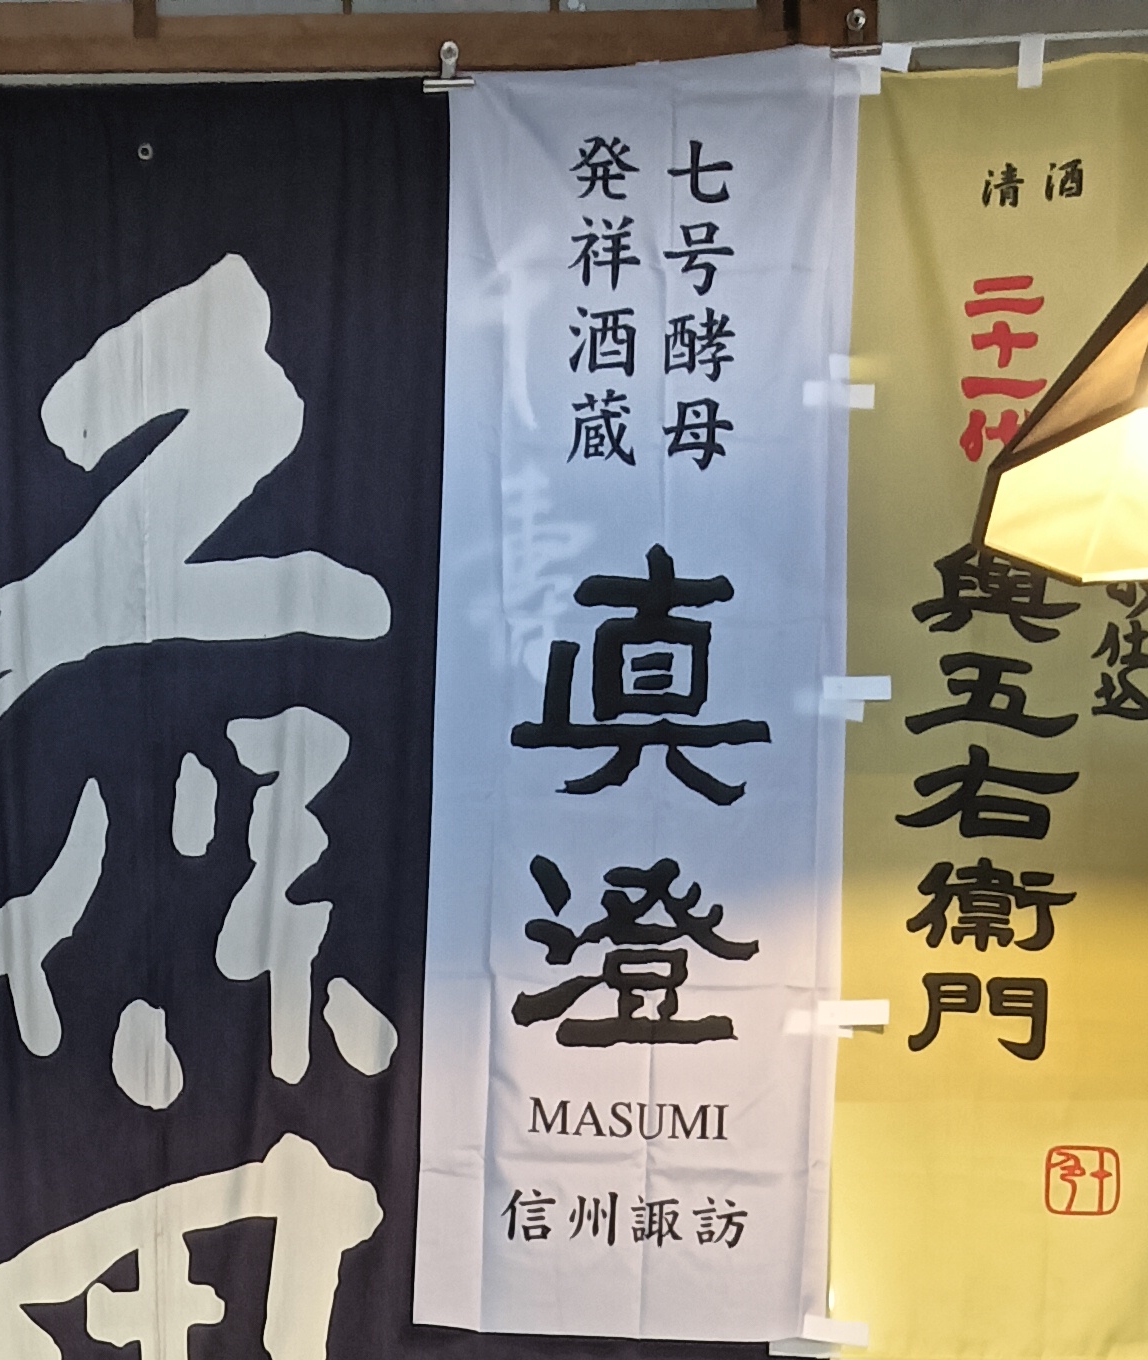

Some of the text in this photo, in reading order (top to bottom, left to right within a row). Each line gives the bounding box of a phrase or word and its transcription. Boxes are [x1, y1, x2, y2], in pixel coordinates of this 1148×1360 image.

[981, 158, 1086, 208] 清酒
[567, 135, 641, 466] 発祥酒蔵
[663, 140, 735, 470] 七号酵母
[510, 543, 773, 1046] 真澄
[527, 1096, 729, 1142] MASUMI
[500, 1188, 749, 1250] 信州諏訪
